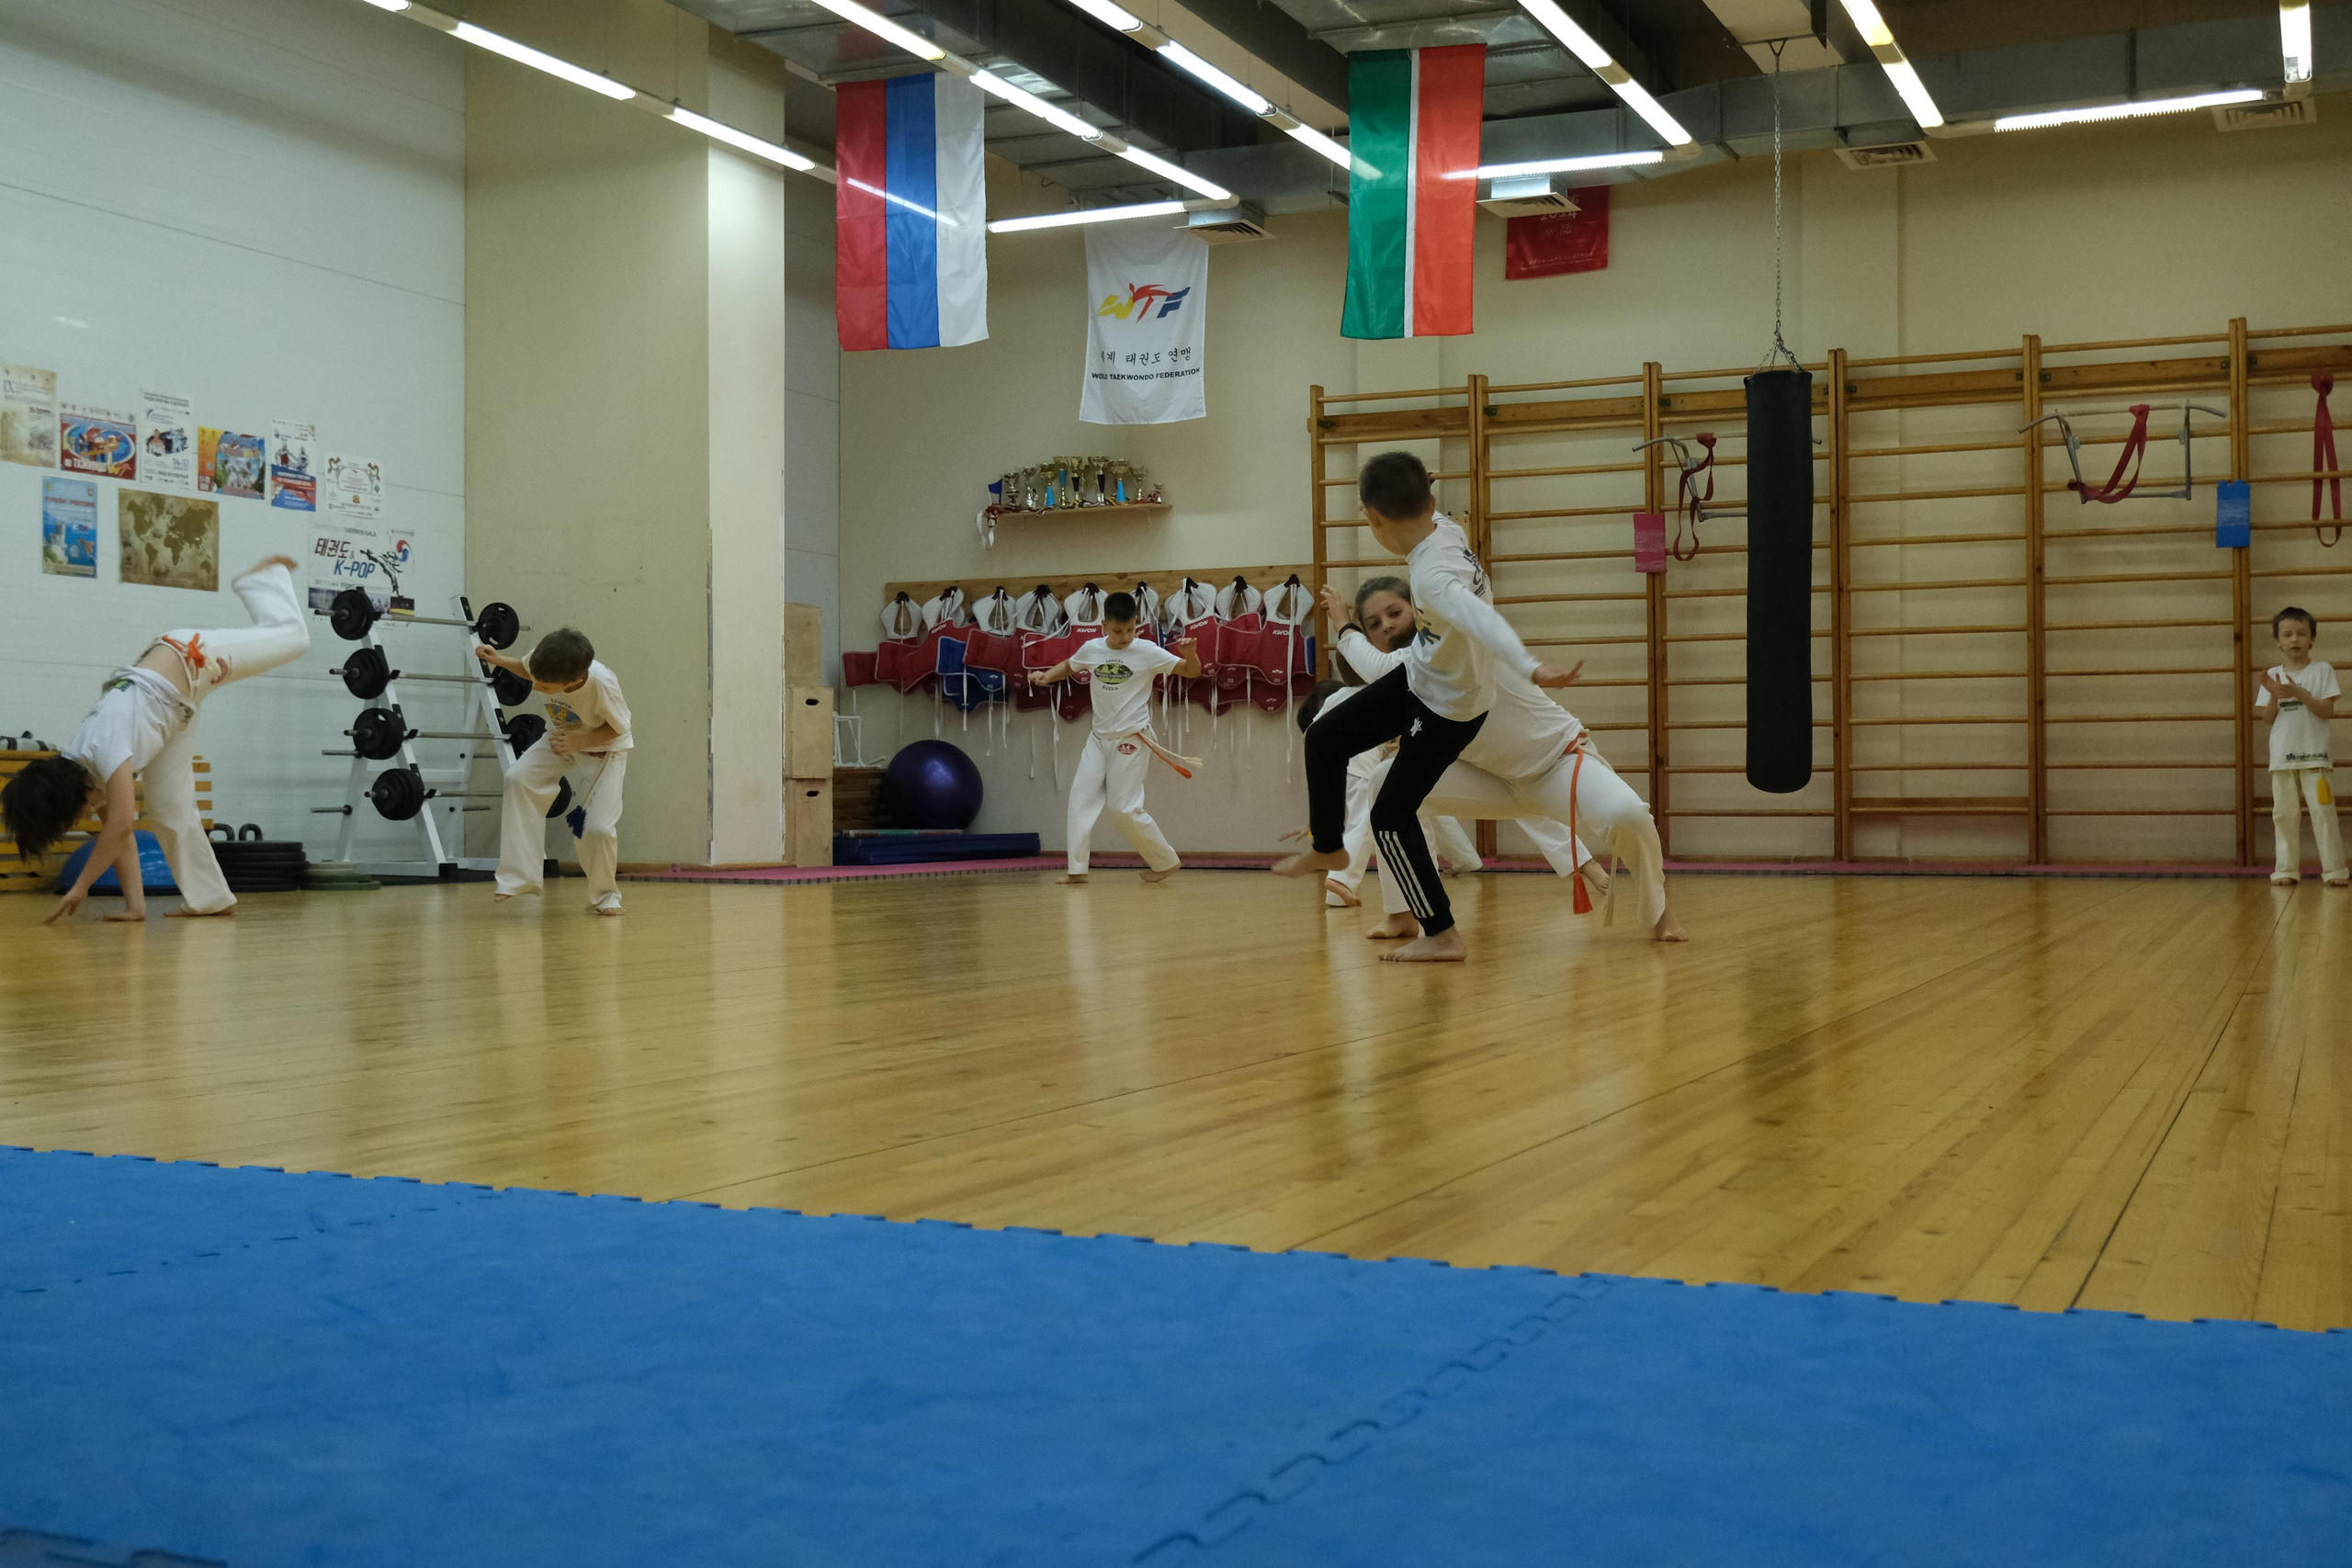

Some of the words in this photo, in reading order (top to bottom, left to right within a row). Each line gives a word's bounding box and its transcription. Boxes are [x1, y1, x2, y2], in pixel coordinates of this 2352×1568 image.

[1096, 282, 1192, 323] WTF
[1168, 346, 1193, 363] 연맹
[1110, 373, 1155, 381] TAEKWONDO
[1155, 367, 1201, 380] FEDERATION
[314, 537, 352, 559] 태권도
[349, 550, 356, 559] &
[334, 559, 377, 580] K-POP
[931, 623, 947, 635] KWON
[1190, 620, 1209, 631] KWON
